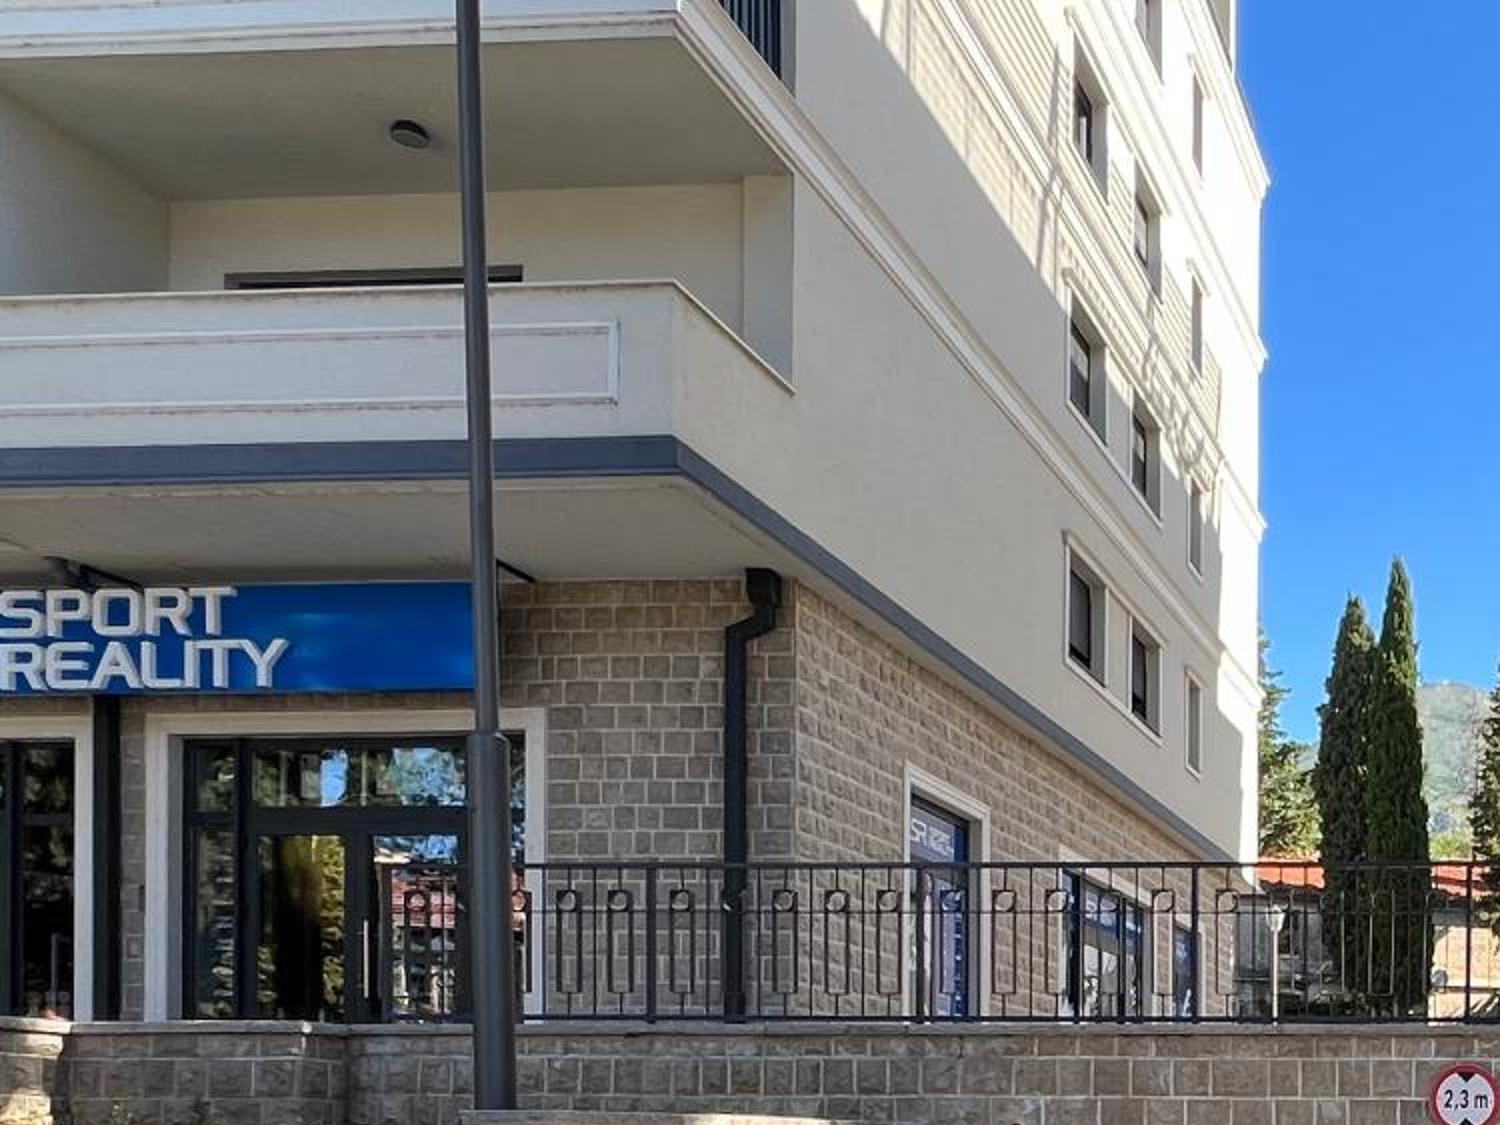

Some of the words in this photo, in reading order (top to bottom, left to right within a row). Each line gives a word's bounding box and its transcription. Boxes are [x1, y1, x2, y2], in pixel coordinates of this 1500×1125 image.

[0, 587, 238, 638] SPORT
[0, 639, 288, 690] REALITY
[1443, 1089, 1469, 1110] 2,3
[1474, 1094, 1489, 1109] m
